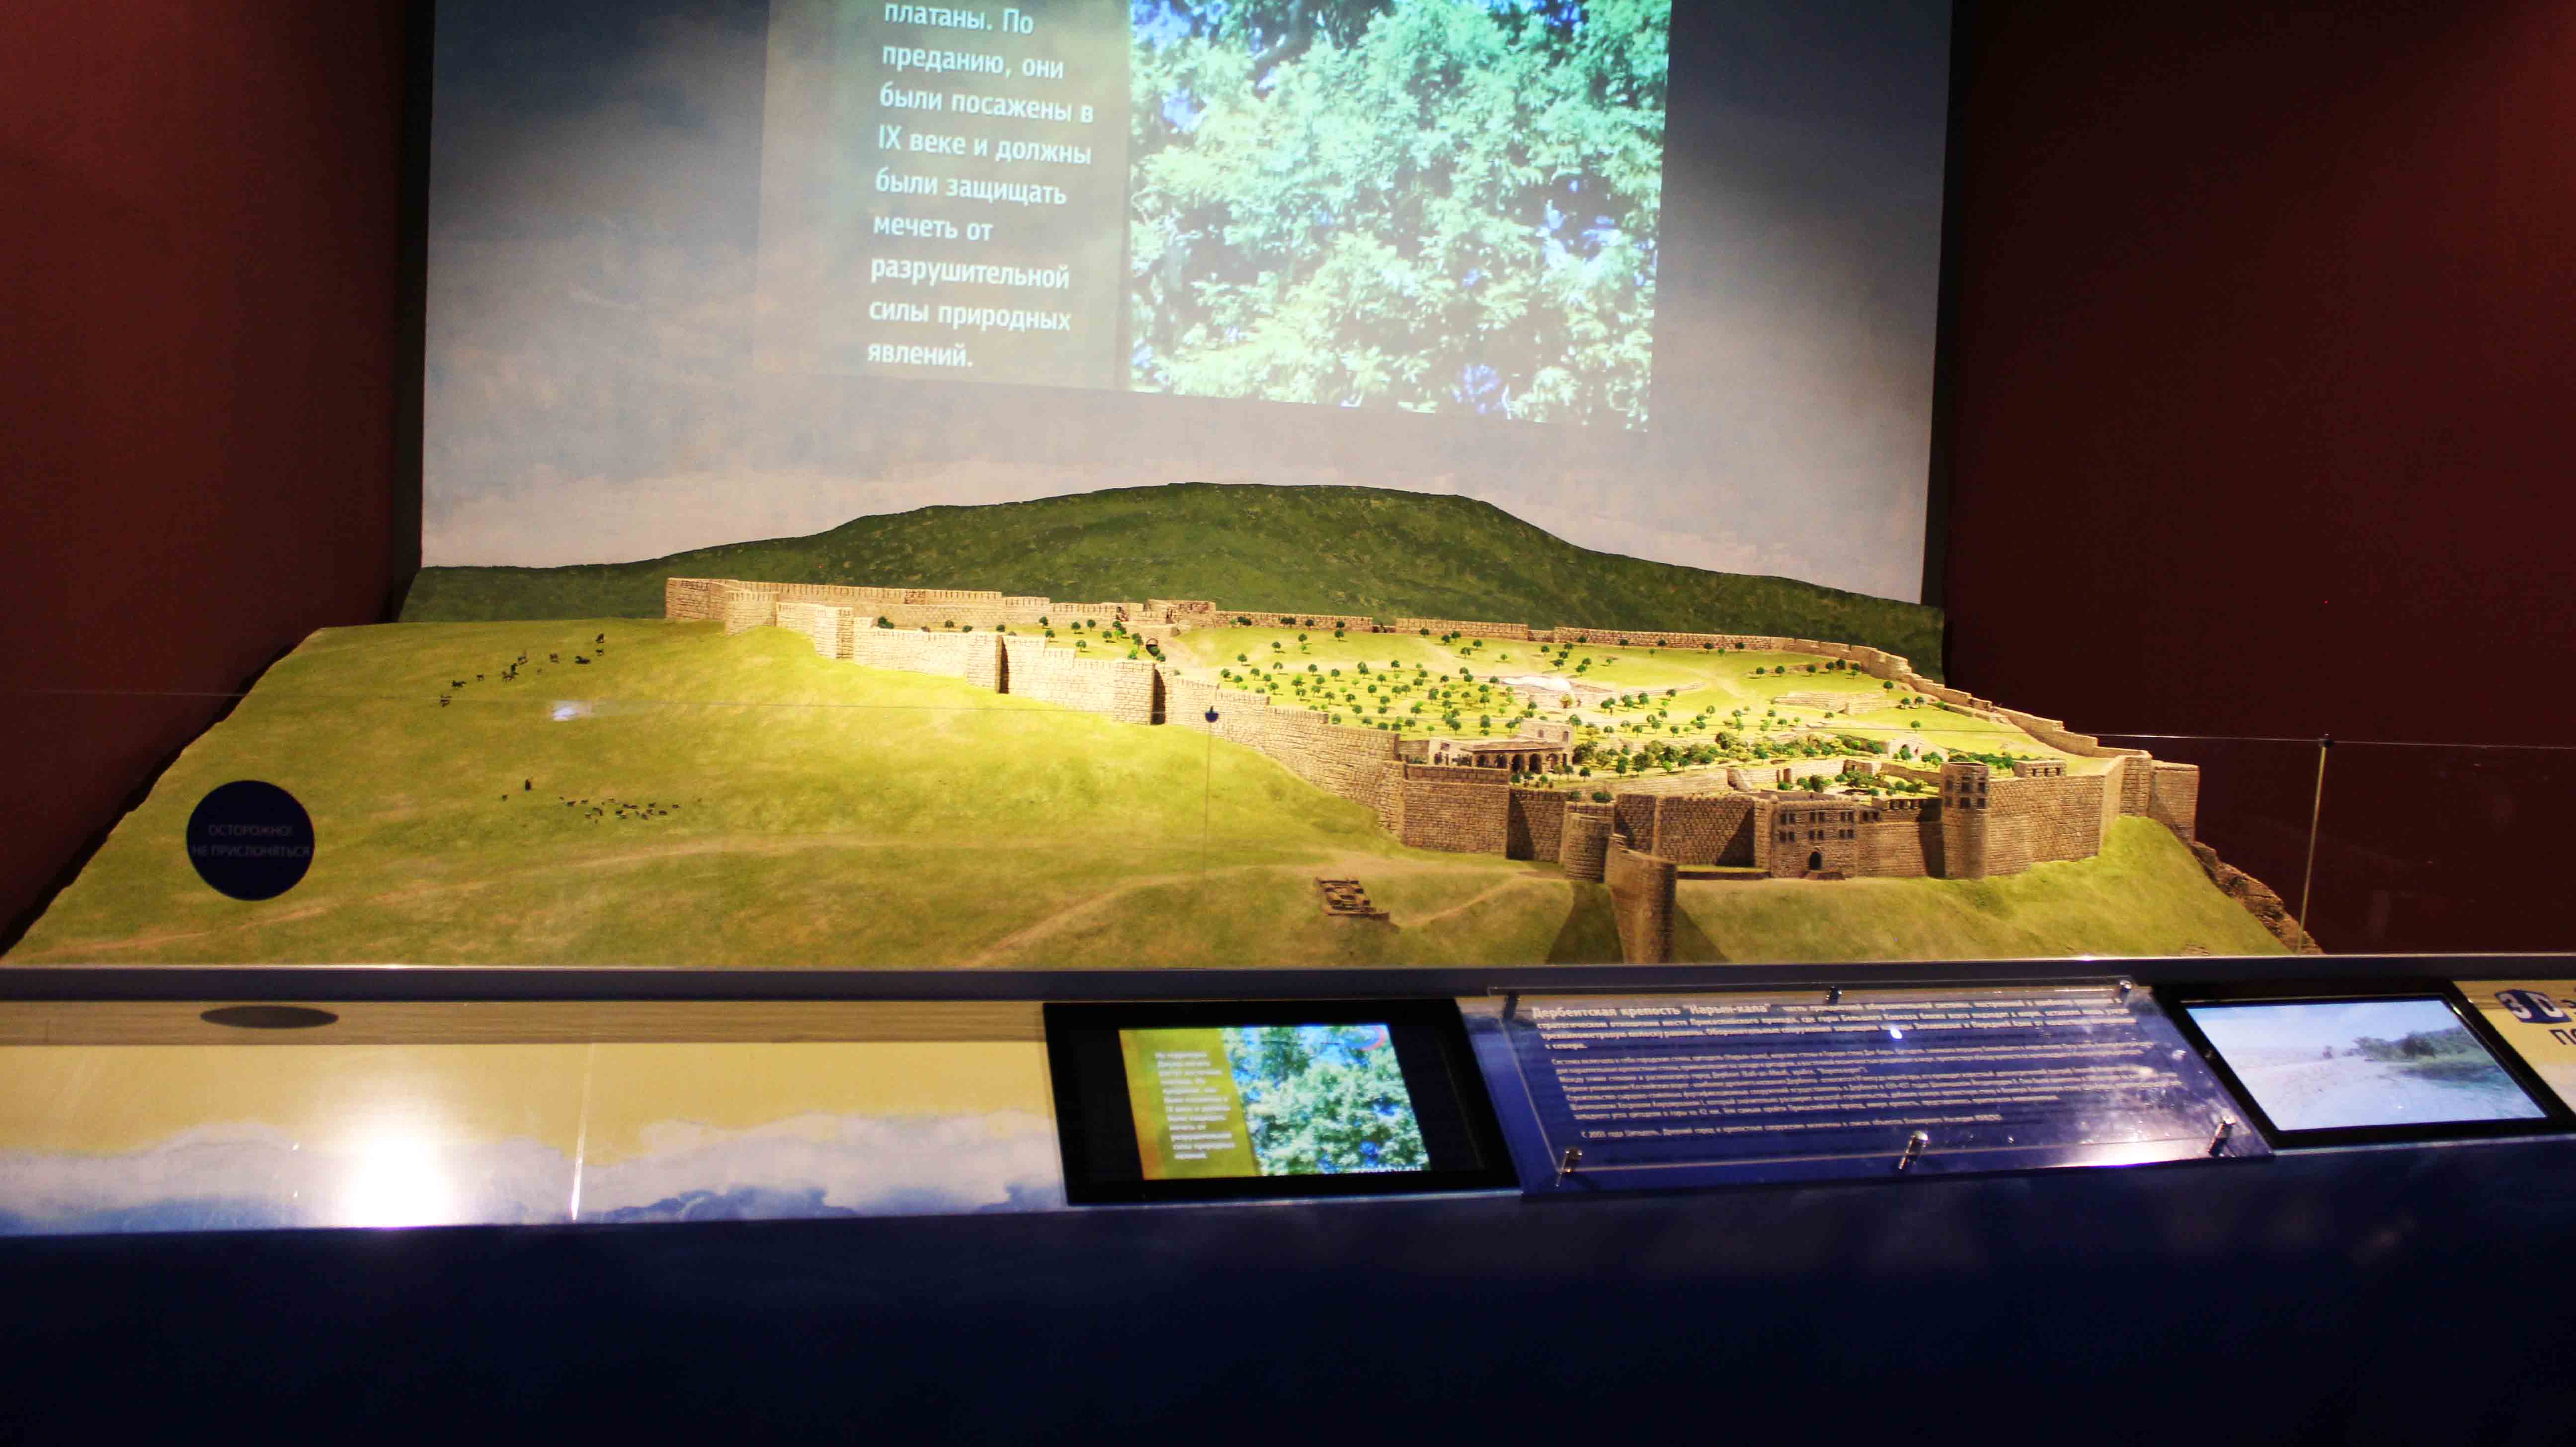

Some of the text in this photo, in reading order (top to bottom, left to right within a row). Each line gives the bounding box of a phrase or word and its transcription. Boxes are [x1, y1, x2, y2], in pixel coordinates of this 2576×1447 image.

[885, 4, 1034, 34] платаны. По
[882, 46, 1064, 79] преданию, они
[879, 81, 1093, 123] были посажены в
[878, 125, 1091, 164] IX веке и должны
[876, 167, 1066, 206] были защищать
[873, 216, 993, 240] мечеть от
[871, 258, 1069, 289] разрушительной
[869, 301, 1071, 331] силы природных
[867, 342, 973, 367] явлений.
[1532, 1007, 1617, 1019] Дербентская
